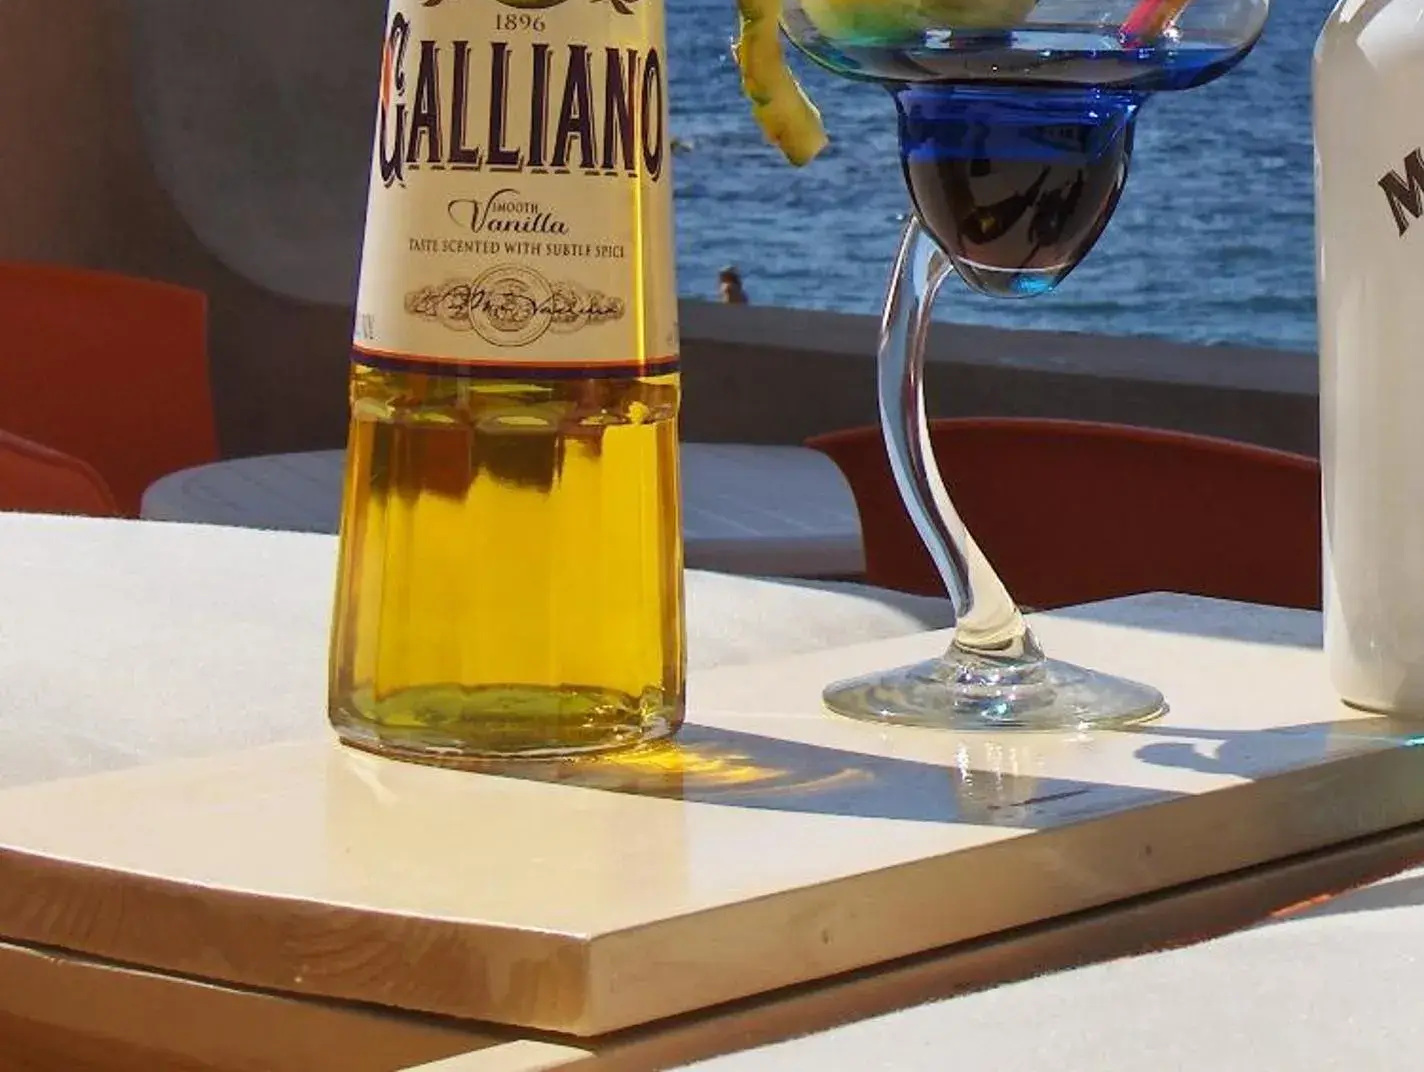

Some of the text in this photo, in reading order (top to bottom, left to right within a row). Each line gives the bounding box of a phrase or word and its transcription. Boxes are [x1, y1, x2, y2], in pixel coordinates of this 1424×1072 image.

[495, 13, 546, 32] 1896
[379, 12, 664, 189] GALLIANO
[447, 188, 570, 235] Vanilla
[409, 238, 438, 253] TASTE
[442, 239, 500, 255] SCENTED
[504, 241, 543, 256] WITH
[546, 243, 591, 258] SUBTLE
